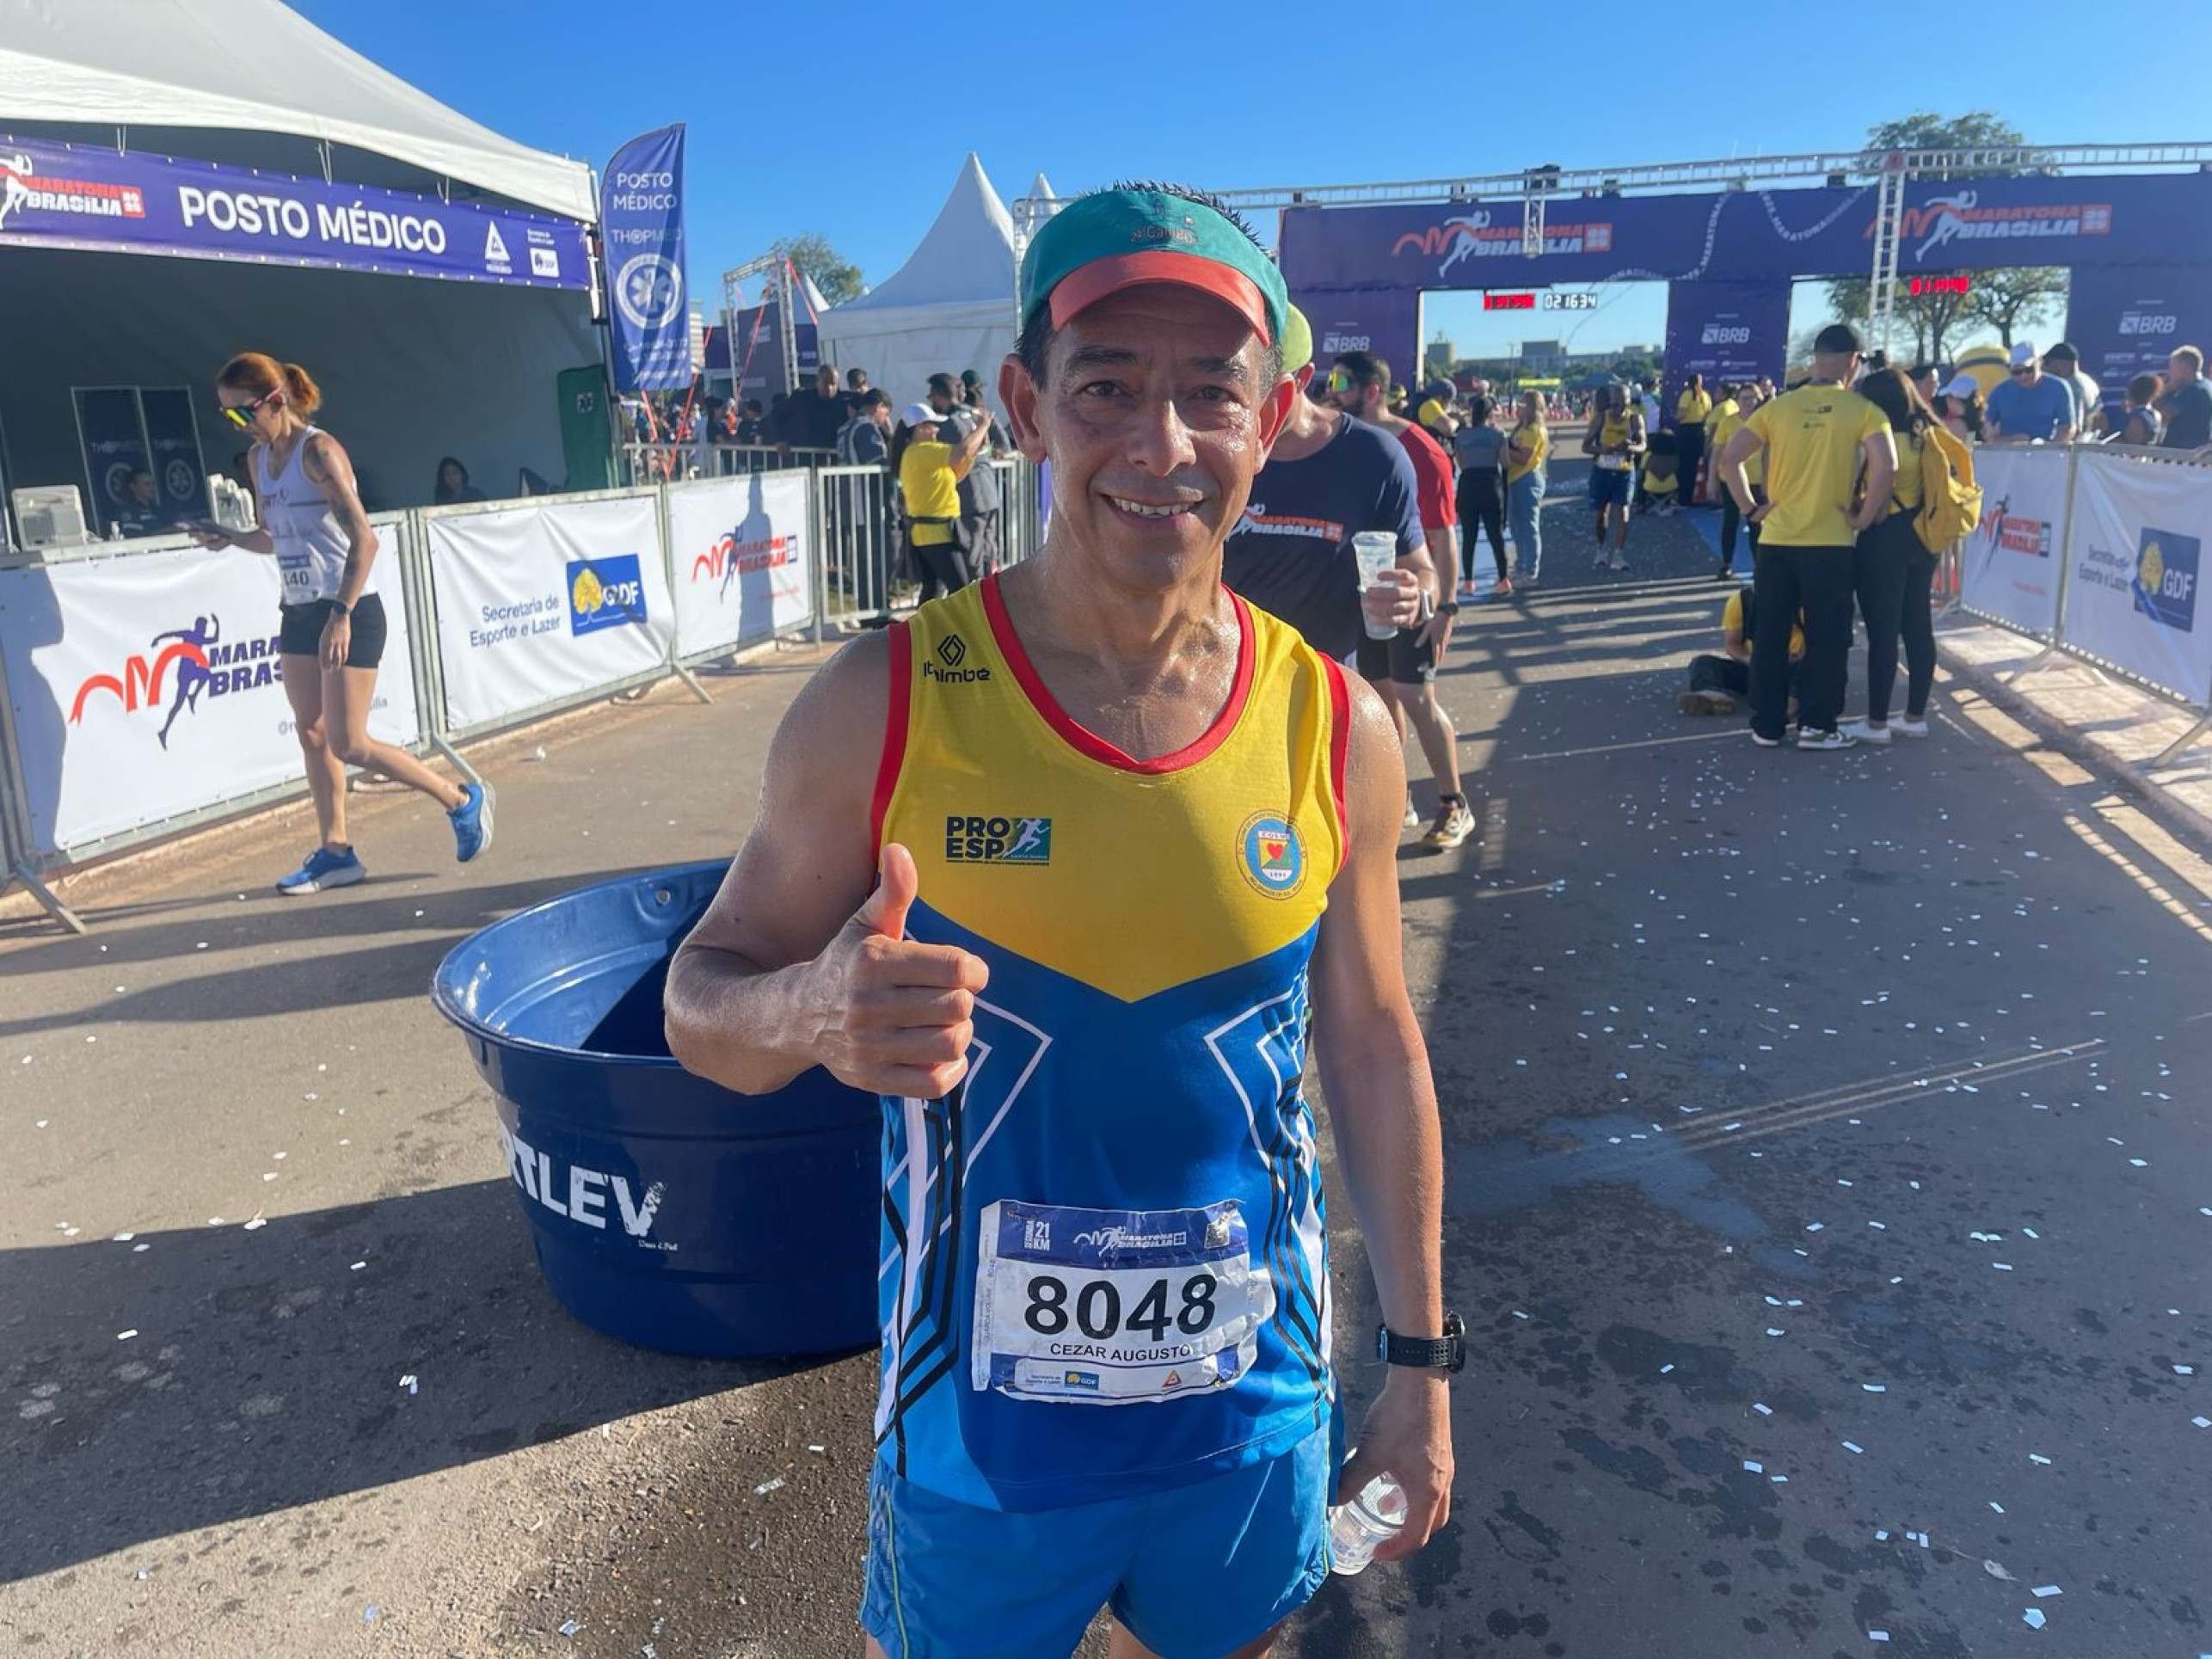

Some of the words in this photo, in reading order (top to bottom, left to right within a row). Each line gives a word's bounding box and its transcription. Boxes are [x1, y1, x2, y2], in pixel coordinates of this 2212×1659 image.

[617, 172, 673, 189] POSTO
[613, 191, 678, 211] MÉDICO
[179, 186, 310, 240] POSTO
[316, 200, 446, 255] MÉDICO
[2139, 316, 2177, 335] BRB
[603, 581, 639, 606] GDF
[2163, 568, 2194, 601] GDF
[482, 598, 543, 623] Secretaria
[545, 593, 558, 610] de
[470, 624, 517, 648] Esporte
[520, 624, 530, 636] e
[531, 617, 561, 636] Lazer
[209, 636, 282, 667] MARA
[946, 816, 1011, 839] PRO
[946, 838, 1005, 859] ESP
[1035, 1221, 1050, 1238] 21
[1034, 1238, 1050, 1251] KM
[1024, 1275, 1217, 1342] 8048
[1050, 1343, 1107, 1359] CEZAR
[1110, 1343, 1191, 1361] AUGUSTO
